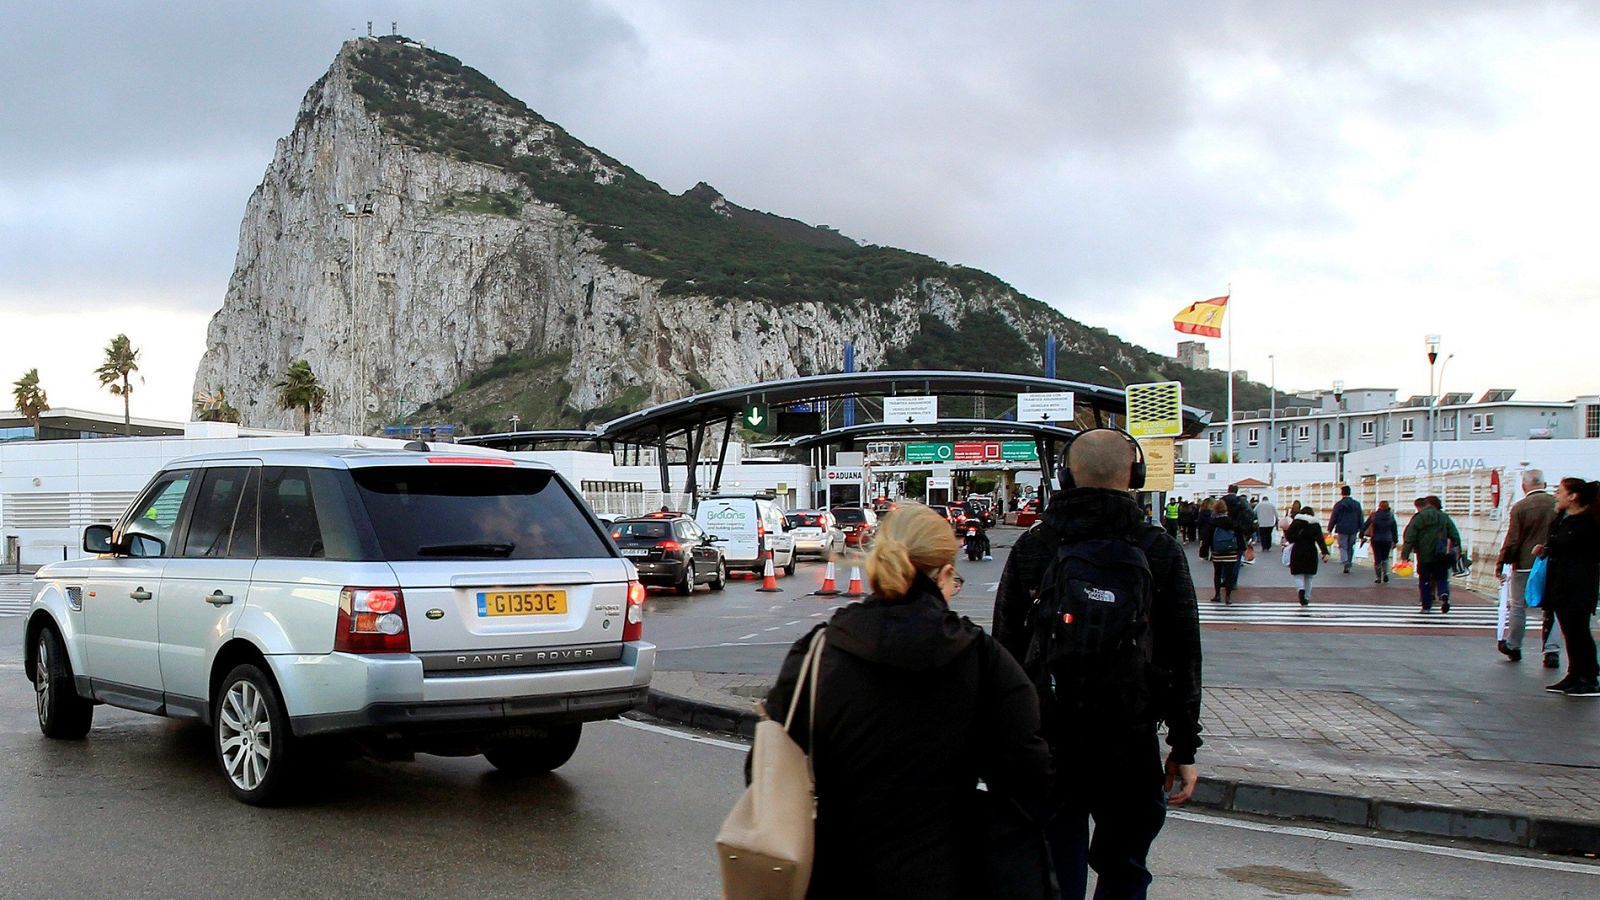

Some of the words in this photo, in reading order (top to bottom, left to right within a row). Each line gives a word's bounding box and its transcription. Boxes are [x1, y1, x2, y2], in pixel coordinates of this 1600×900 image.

[1415, 458, 1486, 471] ADUANA
[836, 472, 862, 480] ADUANA
[457, 654, 523, 665] RANGE
[537, 650, 593, 660] ROVER
